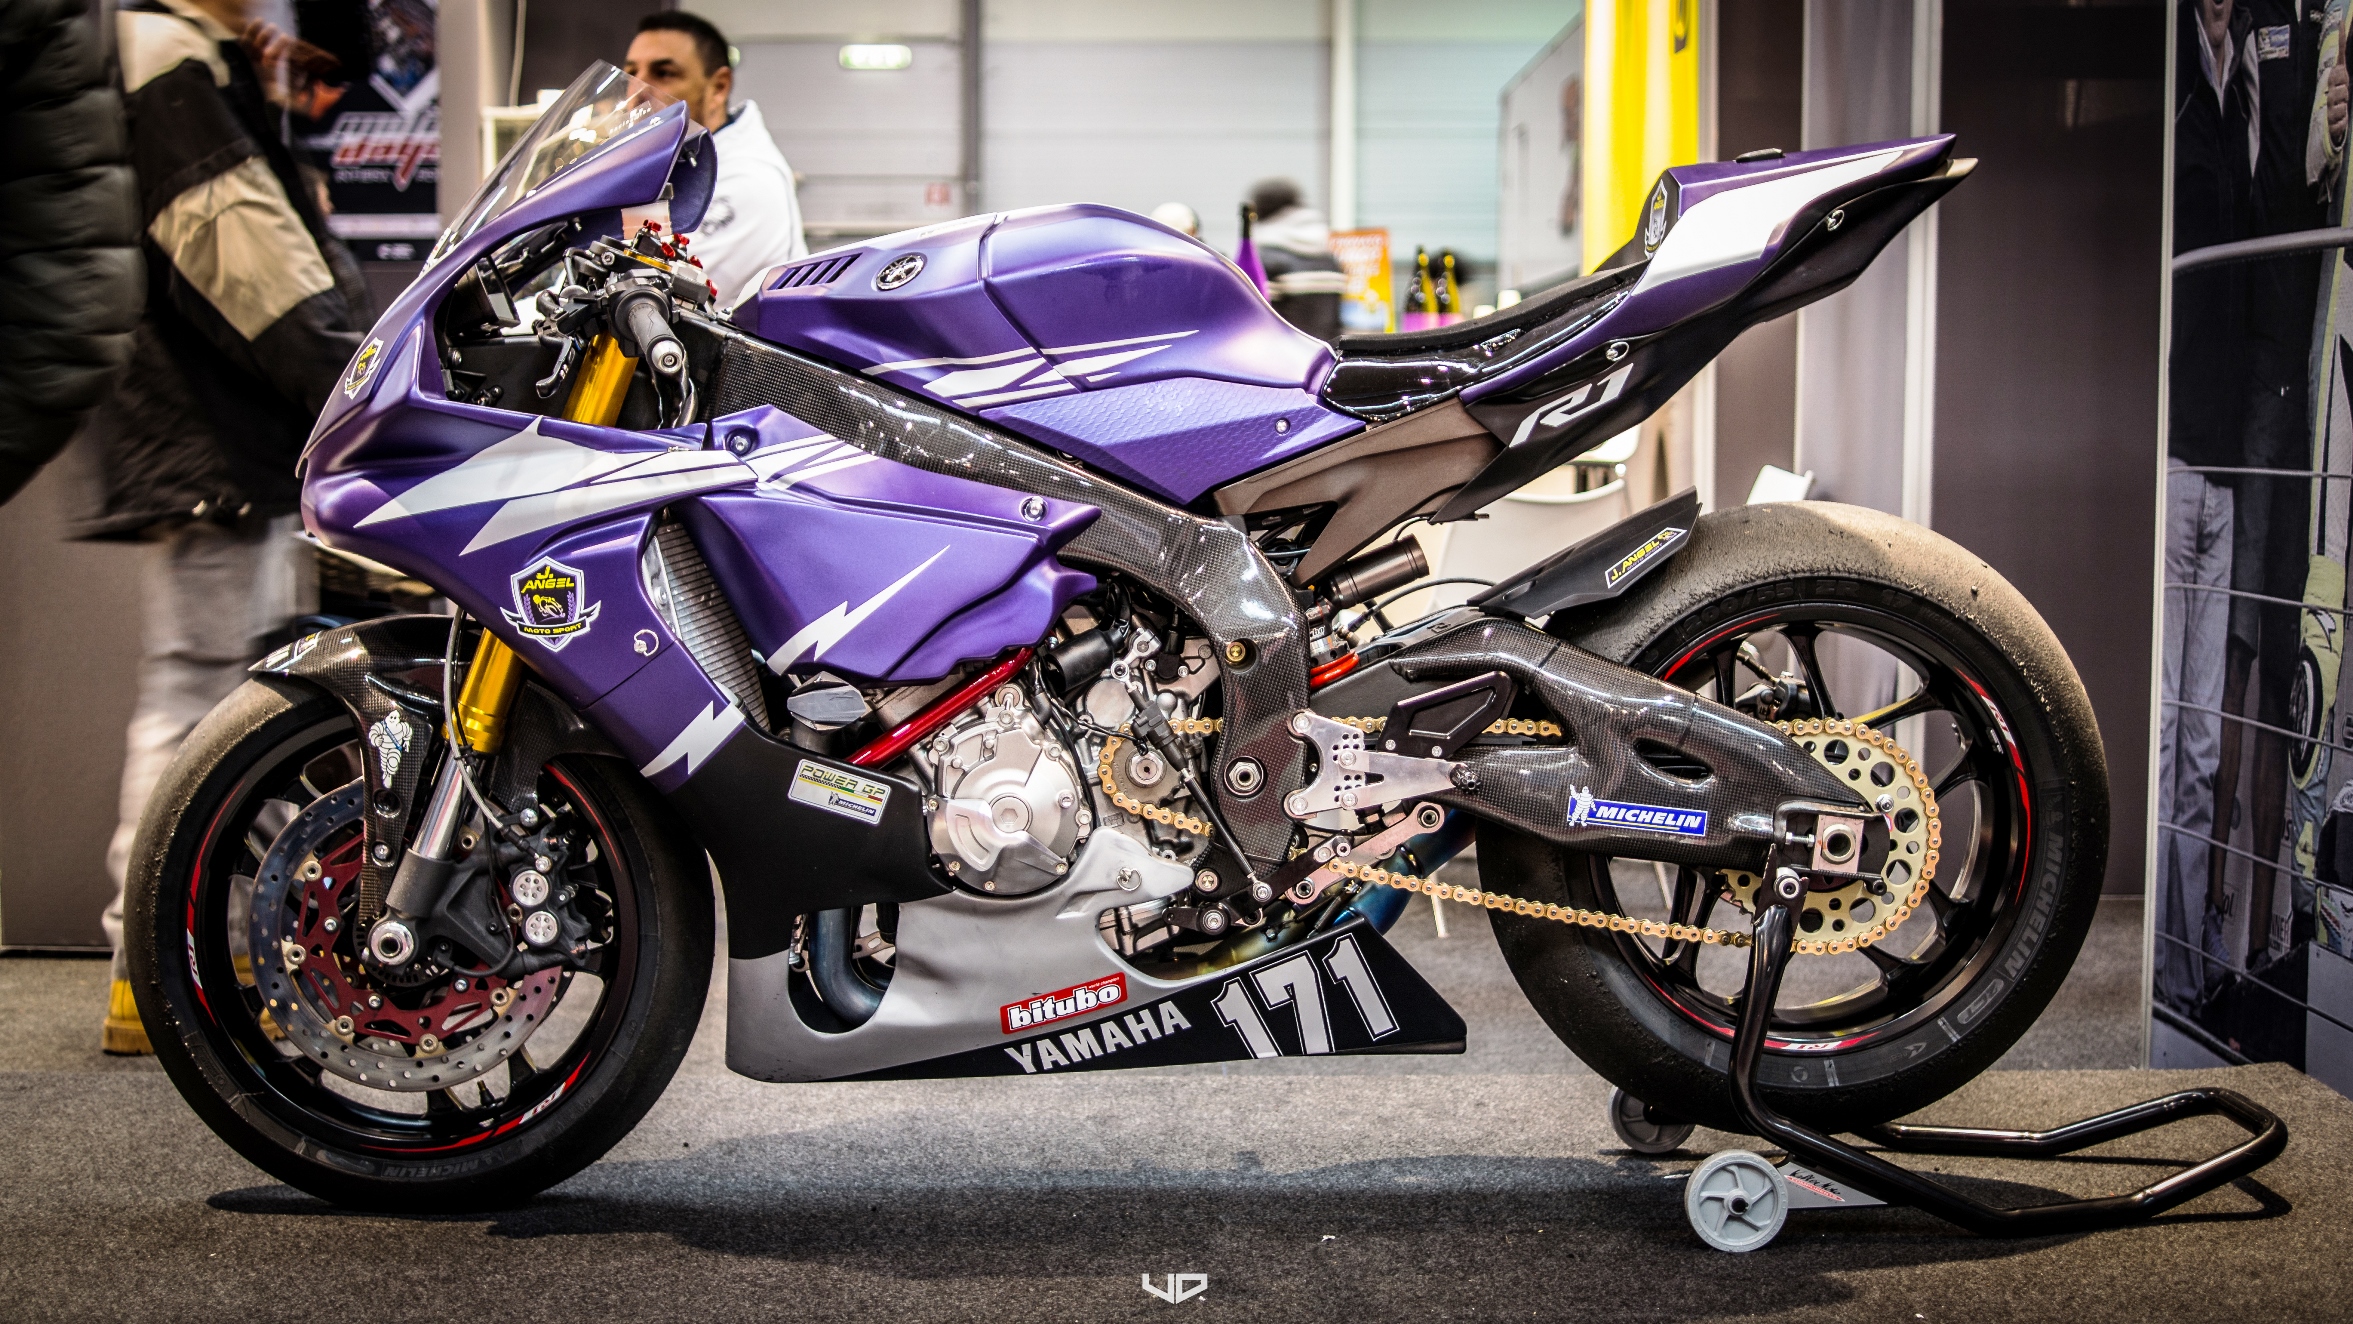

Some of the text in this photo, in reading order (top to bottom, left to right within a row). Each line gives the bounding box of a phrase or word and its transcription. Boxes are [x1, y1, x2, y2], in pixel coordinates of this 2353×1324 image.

[1509, 362, 1634, 448] R1
[536, 565, 554, 579] J.
[521, 577, 575, 594] ANGEL
[523, 622, 582, 635] MOTO SPORT
[801, 765, 886, 795] POWER GP
[838, 799, 875, 814] MICHELIN
[1596, 806, 1703, 828] MICHELIN
[2004, 832, 2064, 979] MICHELIN
[1008, 984, 1122, 1030] bitubo
[1210, 932, 1400, 1059] 171
[1004, 1000, 1192, 1074] YAMAHA
[384, 1159, 480, 1177] MICHELIN
